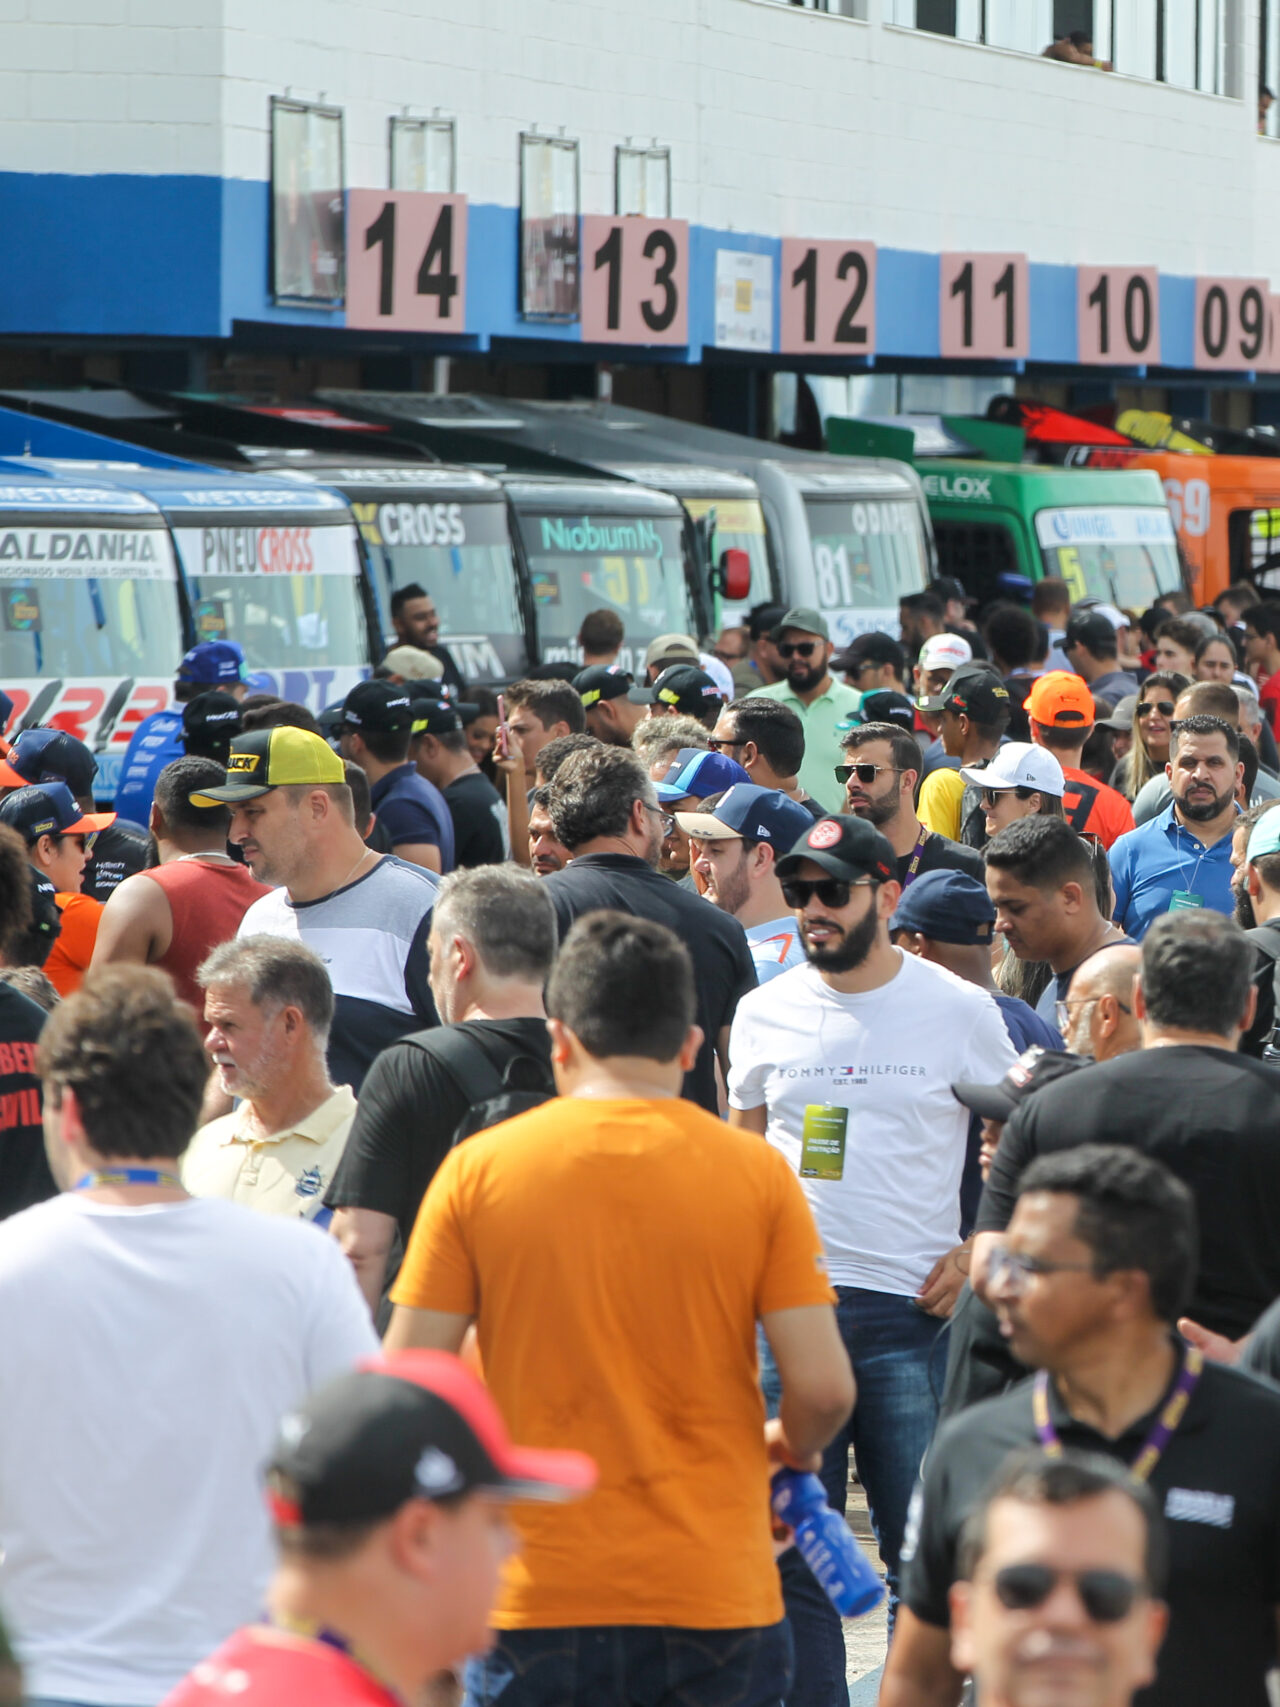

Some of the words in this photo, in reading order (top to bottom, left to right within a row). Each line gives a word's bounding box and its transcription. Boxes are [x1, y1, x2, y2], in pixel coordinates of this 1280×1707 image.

[364, 201, 459, 318] 14
[594, 226, 679, 332] 13
[792, 248, 868, 344] 12
[951, 262, 1015, 348] 11
[1088, 273, 1152, 354] 10
[1203, 285, 1264, 359] 09
[1163, 478, 1211, 537] 69
[815, 543, 853, 608] 81
[1058, 546, 1088, 605] 5
[779, 1066, 836, 1079] TOMMY
[859, 1065, 926, 1076] HILFIGER
